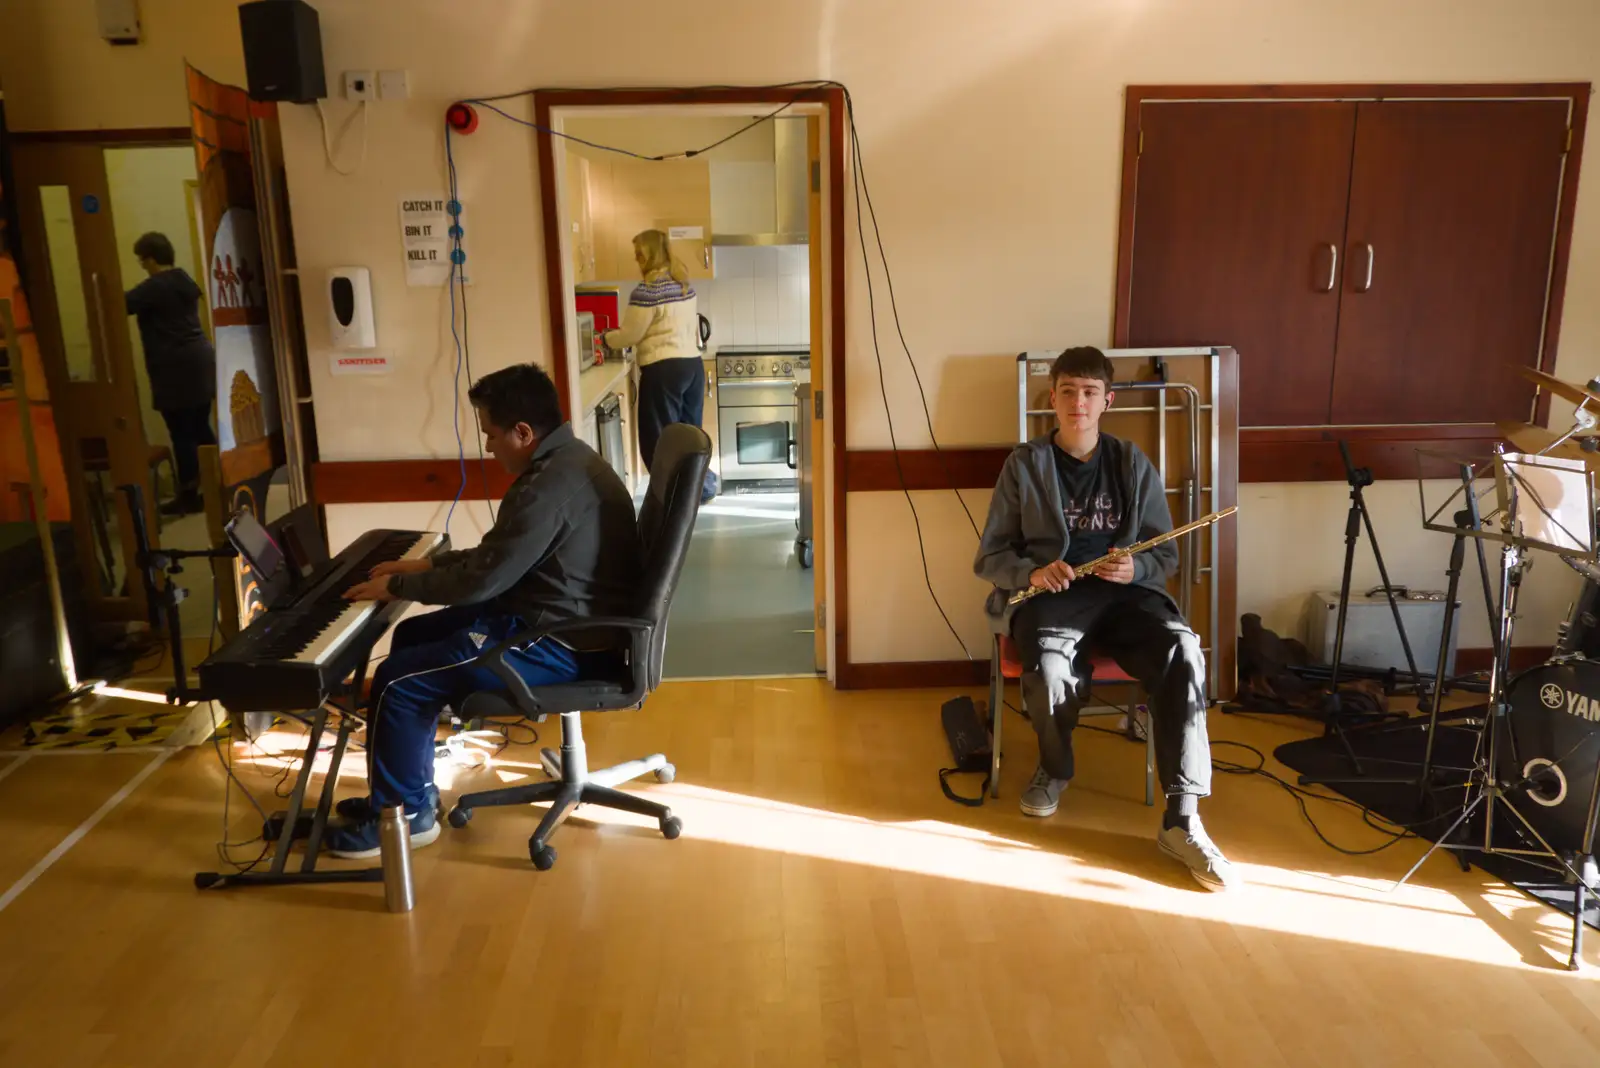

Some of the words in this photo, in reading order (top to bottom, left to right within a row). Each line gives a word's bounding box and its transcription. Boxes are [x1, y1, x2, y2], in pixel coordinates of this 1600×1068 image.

[403, 200, 432, 212] CATCH
[434, 200, 443, 212] IT
[405, 225, 421, 237] BIN
[423, 225, 432, 236] IT
[407, 250, 427, 261] KILL
[429, 250, 437, 261] IT
